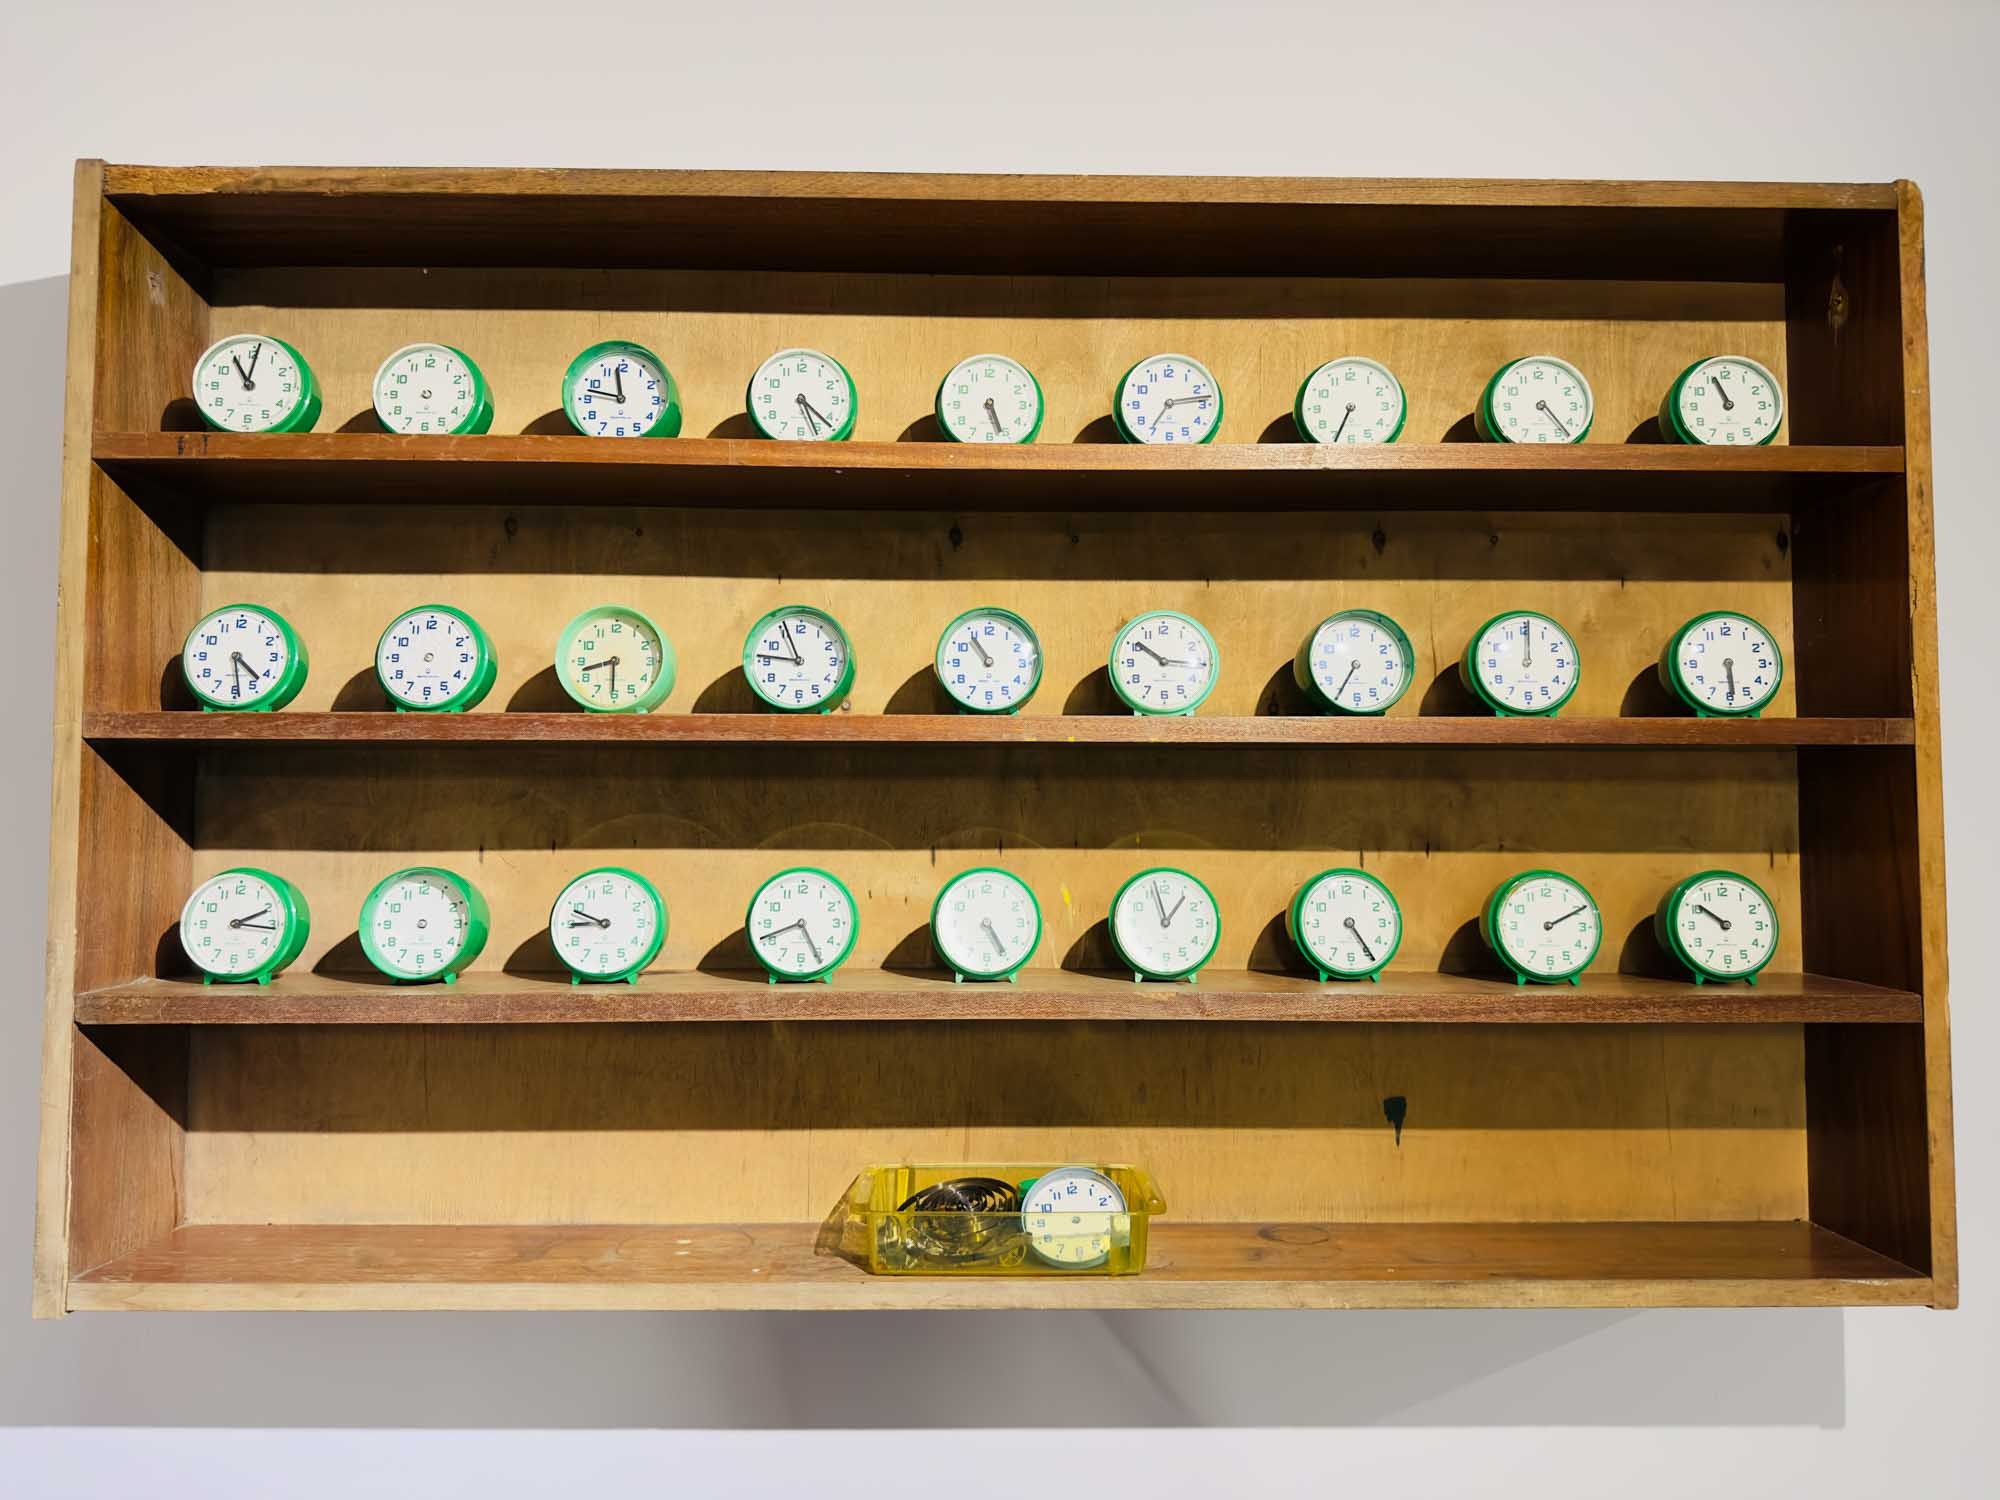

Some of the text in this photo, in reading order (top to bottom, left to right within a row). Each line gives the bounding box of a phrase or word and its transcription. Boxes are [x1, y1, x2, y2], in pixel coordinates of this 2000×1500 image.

[424, 358, 436, 369] 12
[796, 363, 808, 373] 12
[218, 365, 230, 376] 10
[278, 367, 288, 377] 2
[1163, 368, 1175, 378] 12
[1533, 370, 1545, 381] 12
[1719, 369, 1731, 380] 12
[396, 374, 408, 385] 10
[453, 375, 462, 385] 2
[1344, 371, 1356, 382] 12
[282, 382, 292, 393] 3
[589, 379, 601, 389] 10
[769, 378, 781, 389] 10
[825, 380, 835, 391] 2
[457, 390, 466, 400] 3
[957, 384, 969, 395] 10
[1137, 384, 1148, 395] 10
[1192, 384, 1201, 395] 2
[1317, 388, 1330, 399] 10
[1375, 386, 1384, 397] 2
[1562, 386, 1572, 397] 2
[1694, 386, 1706, 397] 10
[1751, 385, 1761, 396] 2
[831, 395, 840, 406] 3
[1018, 400, 1028, 411] 3
[1757, 400, 1767, 411] 3
[450, 406, 459, 416] 4
[1569, 401, 1579, 412] 3
[226, 408, 235, 418] 7
[261, 409, 270, 420] 5
[645, 411, 654, 421] 4
[437, 416, 446, 427] 5
[779, 421, 789, 431] 7
[1013, 416, 1022, 427] 4
[1193, 415, 1201, 426] 4
[1375, 417, 1384, 428] 4
[1565, 417, 1574, 427] 4
[1754, 416, 1762, 426] 4
[599, 421, 608, 432] 7
[632, 422, 641, 432] 5
[969, 426, 977, 437] 7
[1181, 426, 1190, 437] 5
[235, 618, 248, 629] 12
[426, 620, 438, 630] 12
[611, 623, 623, 634] 12
[795, 624, 807, 634] 12
[984, 625, 995, 636] 12
[1158, 625, 1169, 635] 12
[1719, 626, 1732, 637] 12
[205, 635, 218, 646] 10
[265, 636, 275, 647] 2
[397, 636, 409, 648] 10
[455, 637, 465, 647] 2
[583, 640, 595, 651] 10
[768, 640, 780, 651] 10
[957, 642, 969, 653] 10
[1379, 644, 1388, 655] 2
[1550, 642, 1559, 653] 2
[1751, 643, 1761, 653] 2
[269, 652, 279, 662] 3
[459, 653, 469, 663] 3
[1384, 660, 1394, 670] 3
[1556, 658, 1565, 669] 3
[1758, 658, 1767, 669] 3
[262, 668, 271, 678] 4
[453, 669, 461, 680] 4
[639, 673, 648, 683] 4
[823, 673, 831, 683] 4
[1380, 676, 1389, 686] 4
[1551, 674, 1560, 685] 4
[1754, 675, 1762, 685] 4
[439, 681, 448, 691] 5
[593, 684, 602, 694] 7
[627, 684, 636, 695] 5
[778, 684, 787, 694] 7
[811, 684, 820, 694] 5
[968, 685, 977, 695] 7
[1000, 685, 1009, 696] 5
[1143, 685, 1152, 695] 7
[1176, 684, 1185, 695] 5
[1540, 686, 1549, 696] 5
[1708, 686, 1717, 697] 7
[1742, 686, 1751, 697] 5
[1368, 687, 1377, 698] 5
[235, 884, 247, 896] 12
[602, 883, 614, 896] 12
[797, 884, 809, 895] 12
[1340, 884, 1353, 895] 12
[1540, 887, 1552, 898] 12
[1716, 887, 1728, 897] 12
[206, 902, 218, 913] 10
[390, 902, 401, 914] 10
[632, 901, 642, 913] 2
[769, 901, 781, 913] 10
[827, 901, 836, 913] 2
[1315, 901, 1327, 913] 10
[1371, 901, 1381, 913] 2
[1513, 903, 1526, 915] 10
[1748, 904, 1757, 915] 2
[832, 917, 841, 929] 3
[1195, 917, 1205, 929] 3
[1378, 918, 1387, 929] 3
[1578, 921, 1587, 933] 3
[1754, 920, 1764, 931] 3
[260, 936, 269, 947] 4
[447, 936, 455, 946] 4
[630, 935, 639, 946] 4
[826, 935, 835, 946] 4
[1191, 935, 1199, 945] 4
[1374, 935, 1382, 945] 4
[1574, 939, 1582, 949] 4
[1751, 938, 1759, 948] 4
[213, 948, 223, 959] 7
[399, 948, 408, 959] 7
[433, 948, 442, 959] 5
[583, 948, 592, 959] 7
[616, 947, 626, 959] 5
[1178, 946, 1187, 958] 5
[1562, 950, 1571, 961] 5
[1706, 949, 1715, 960] 7
[1739, 949, 1748, 960] 5
[1066, 1185, 1078, 1195] 12
[1052, 1191, 1061, 1201] 11
[1098, 1196, 1108, 1207] 2
[1040, 1203, 1053, 1214] 10
